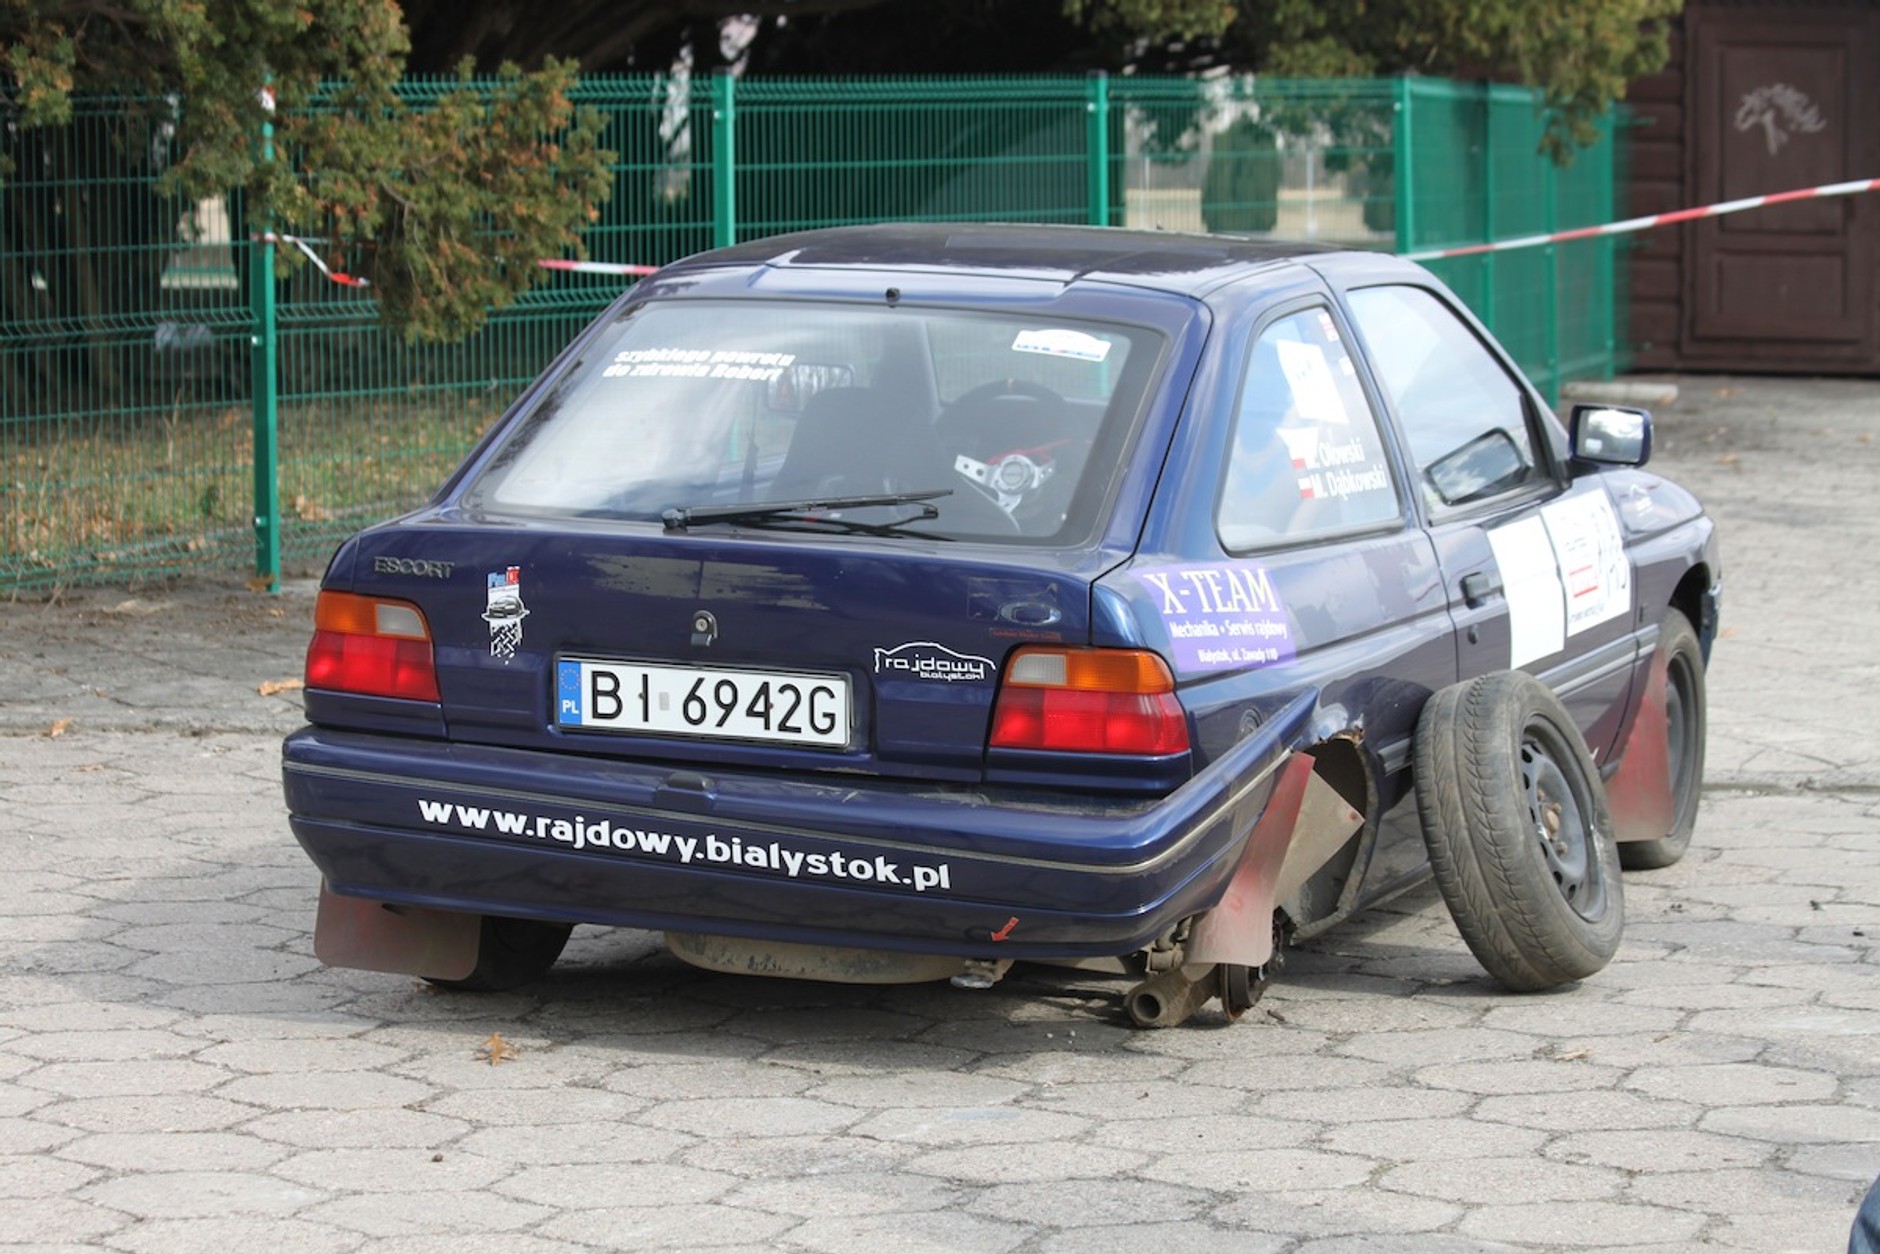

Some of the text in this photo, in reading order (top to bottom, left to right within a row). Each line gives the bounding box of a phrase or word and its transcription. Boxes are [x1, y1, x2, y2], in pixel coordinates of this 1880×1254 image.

[616, 350, 794, 365] szybkiego powrotu
[603, 364, 783, 380] do zdrowia Robert
[374, 556, 455, 578] ESCORT
[1143, 569, 1279, 614] X-TEAM
[1169, 620, 1220, 638] Mechanika
[1225, 620, 1255, 636] Serwis
[885, 654, 983, 679] rajdowy
[562, 701, 579, 714] PL
[682, 677, 836, 735] 6942G
[418, 799, 952, 891] www.rajdowy.bialystok.pl
